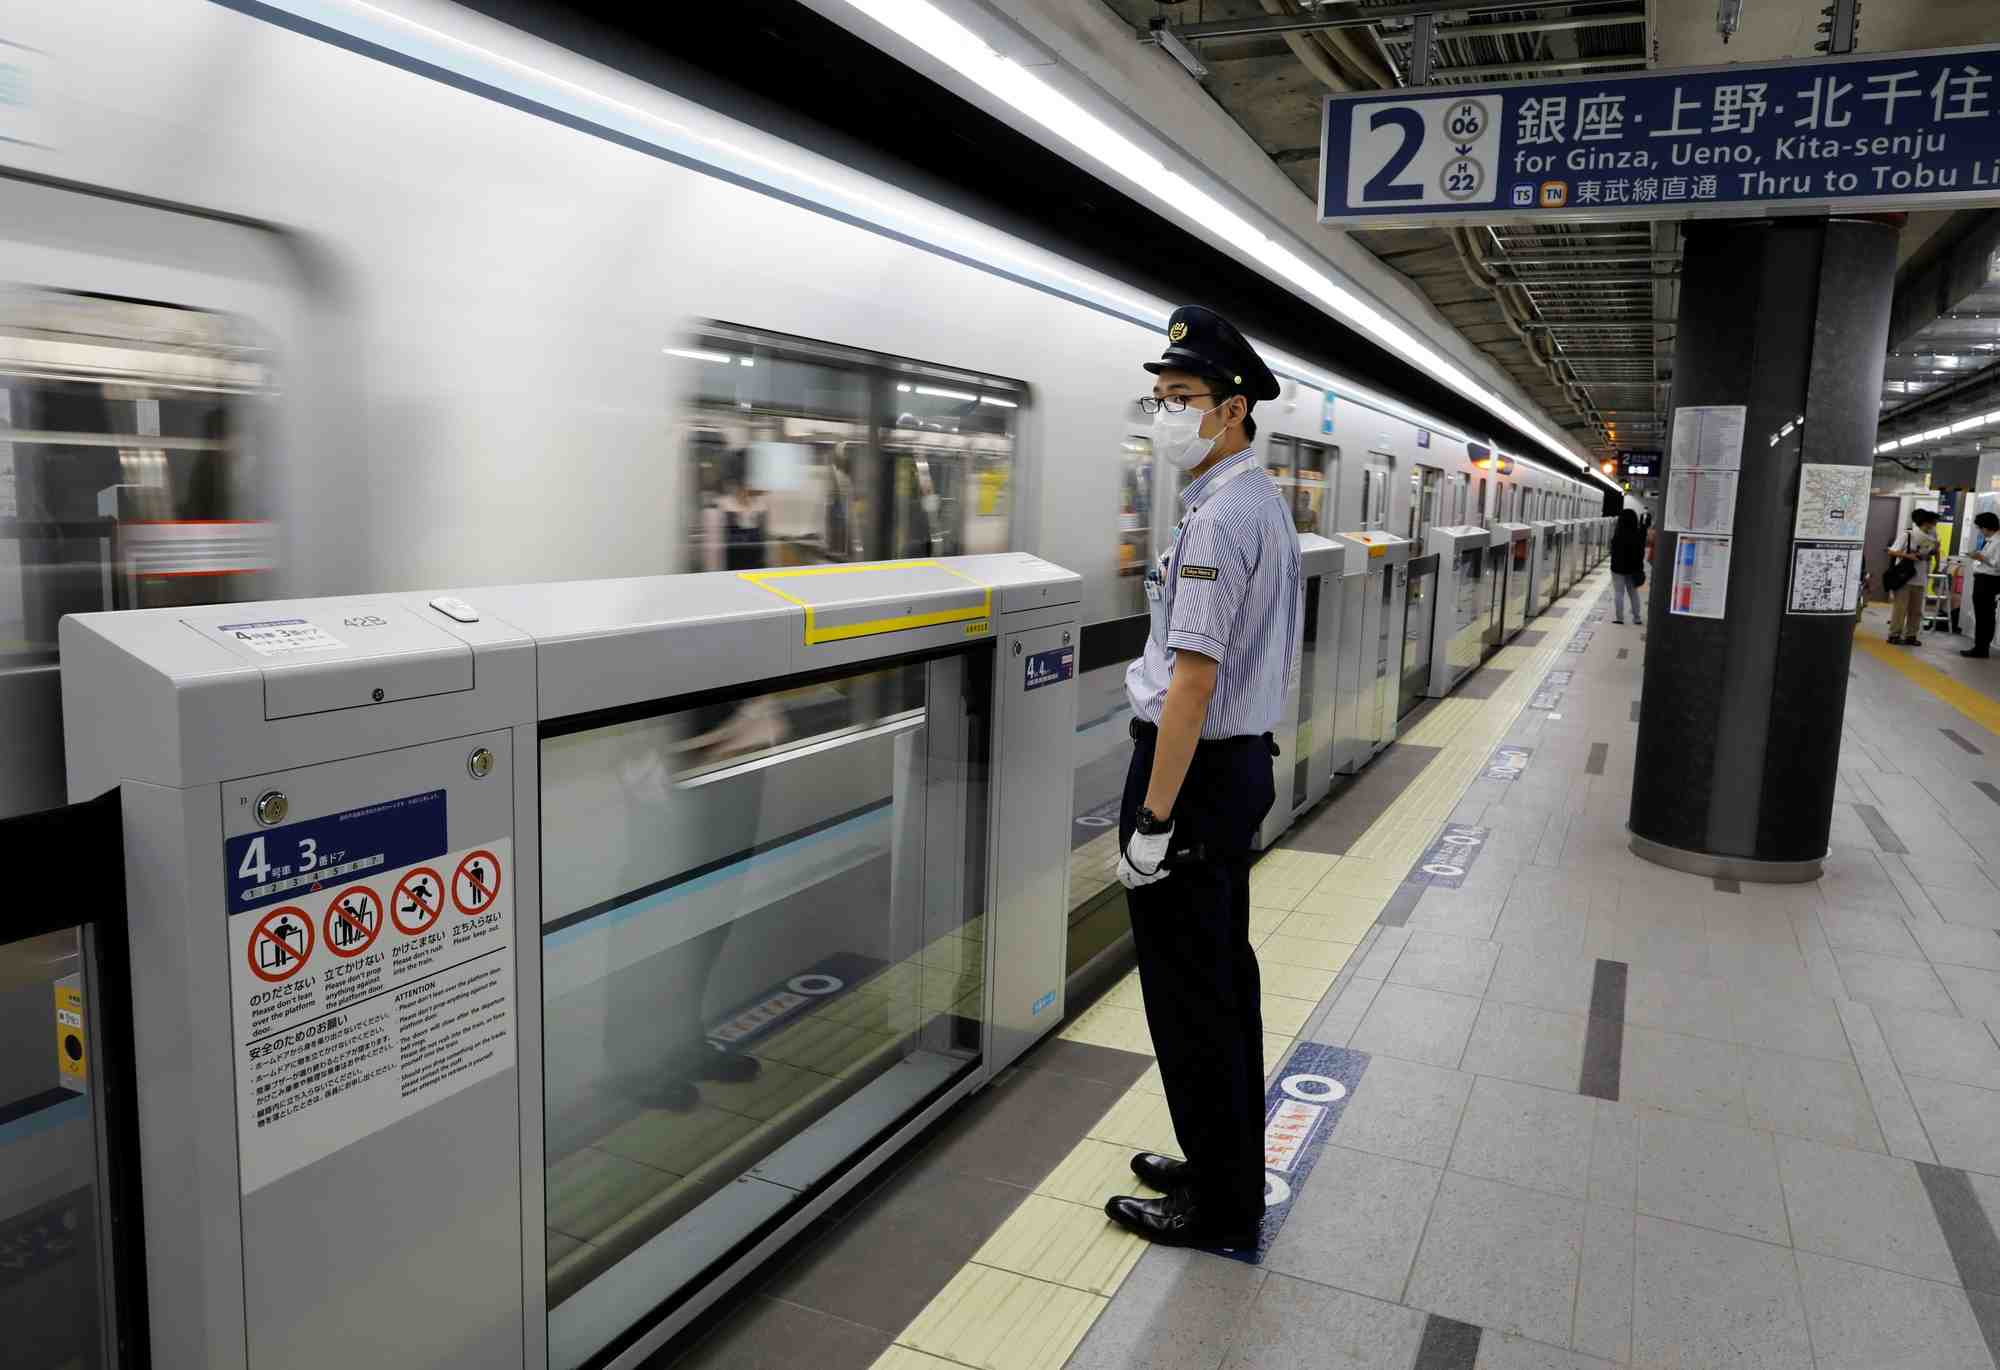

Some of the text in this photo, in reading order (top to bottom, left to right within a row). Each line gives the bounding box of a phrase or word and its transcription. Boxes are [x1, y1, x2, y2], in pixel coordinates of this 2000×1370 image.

[1461, 106, 1472, 117] H
[1451, 118, 1478, 136] 06
[1363, 106, 1426, 202] 2
[1514, 128, 1947, 174] for Ginza, Ueno, Kita-senju
[1457, 163, 1468, 174] H
[1448, 174, 1475, 192] 22
[1516, 190, 1531, 201] TS
[1546, 188, 1562, 200] TN
[1575, 174, 1718, 204] 東武線直通
[1738, 171, 1812, 196] Thru
[1824, 170, 1858, 192] to
[1871, 162, 1958, 191] Tobu
[324, 951, 385, 983] 立てかけない
[248, 976, 317, 1008] のりださない
[394, 980, 435, 1003] ATTENTION
[252, 1004, 276, 1018] Please
[248, 1013, 349, 1062] 安全のためのお願い
